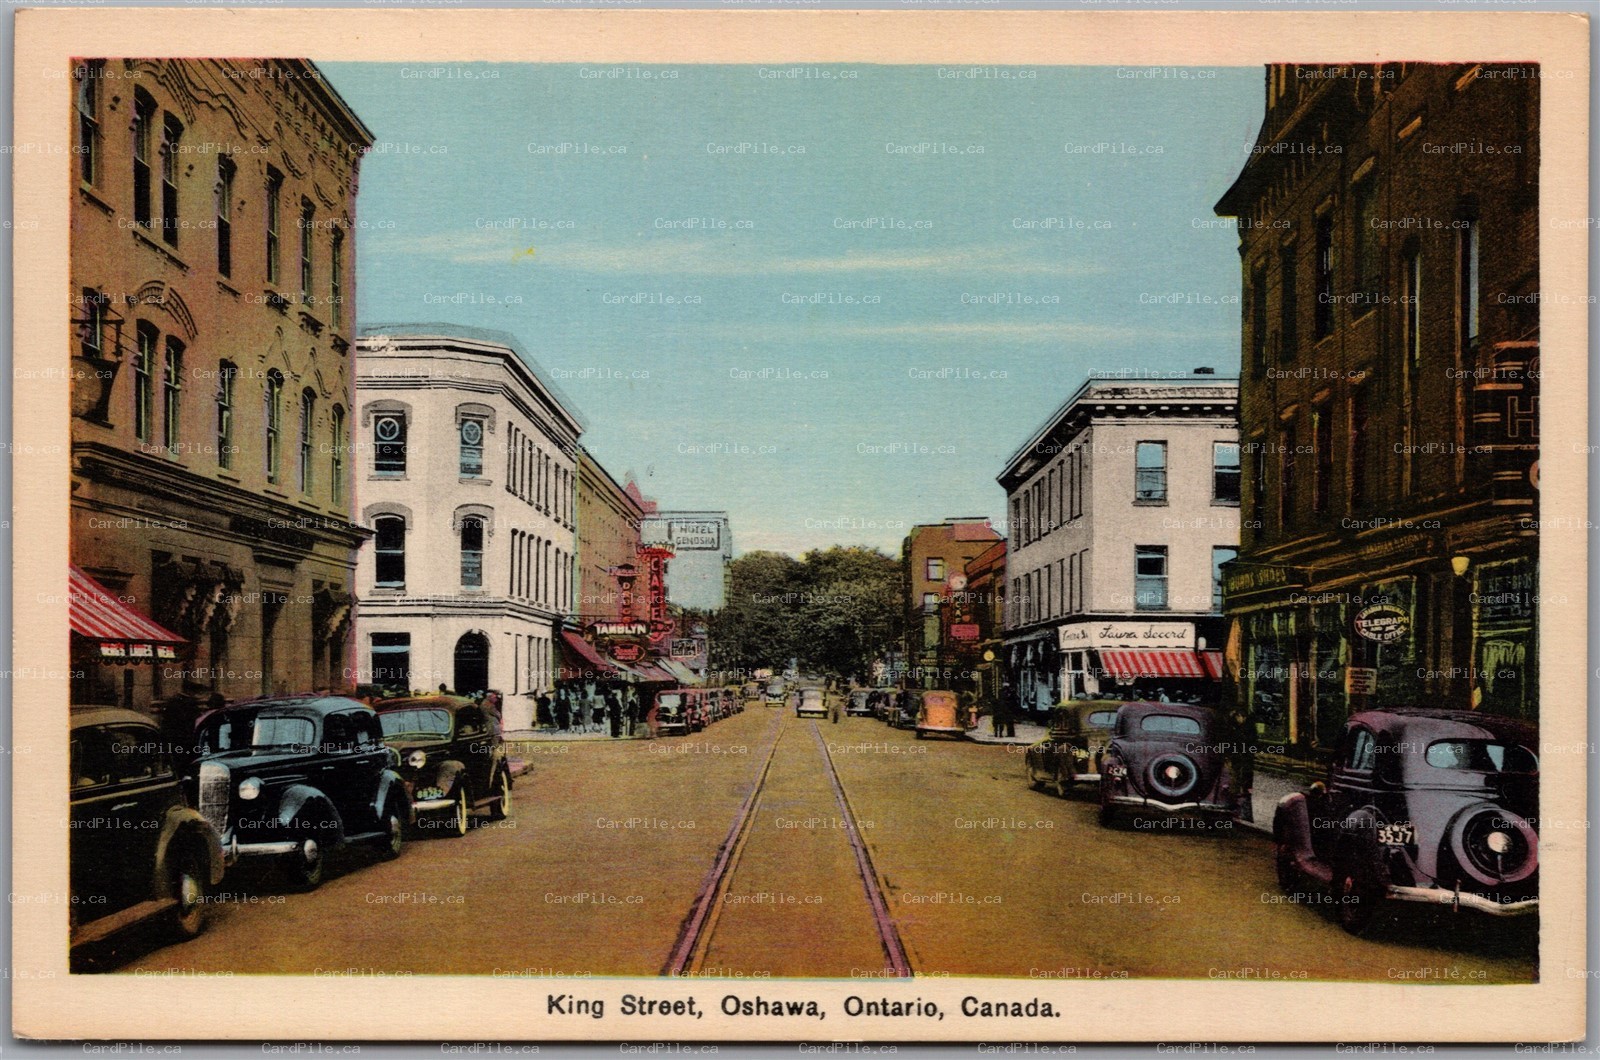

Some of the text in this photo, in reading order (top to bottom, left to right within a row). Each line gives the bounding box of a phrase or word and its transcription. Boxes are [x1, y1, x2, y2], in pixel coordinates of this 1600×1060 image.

[680, 526, 714, 534] HOTEL
[1355, 616, 1410, 628] TELEGRAPH
[1099, 624, 1187, 639] Laura Secord
[1360, 625, 1407, 640] CABLE OFFICE
